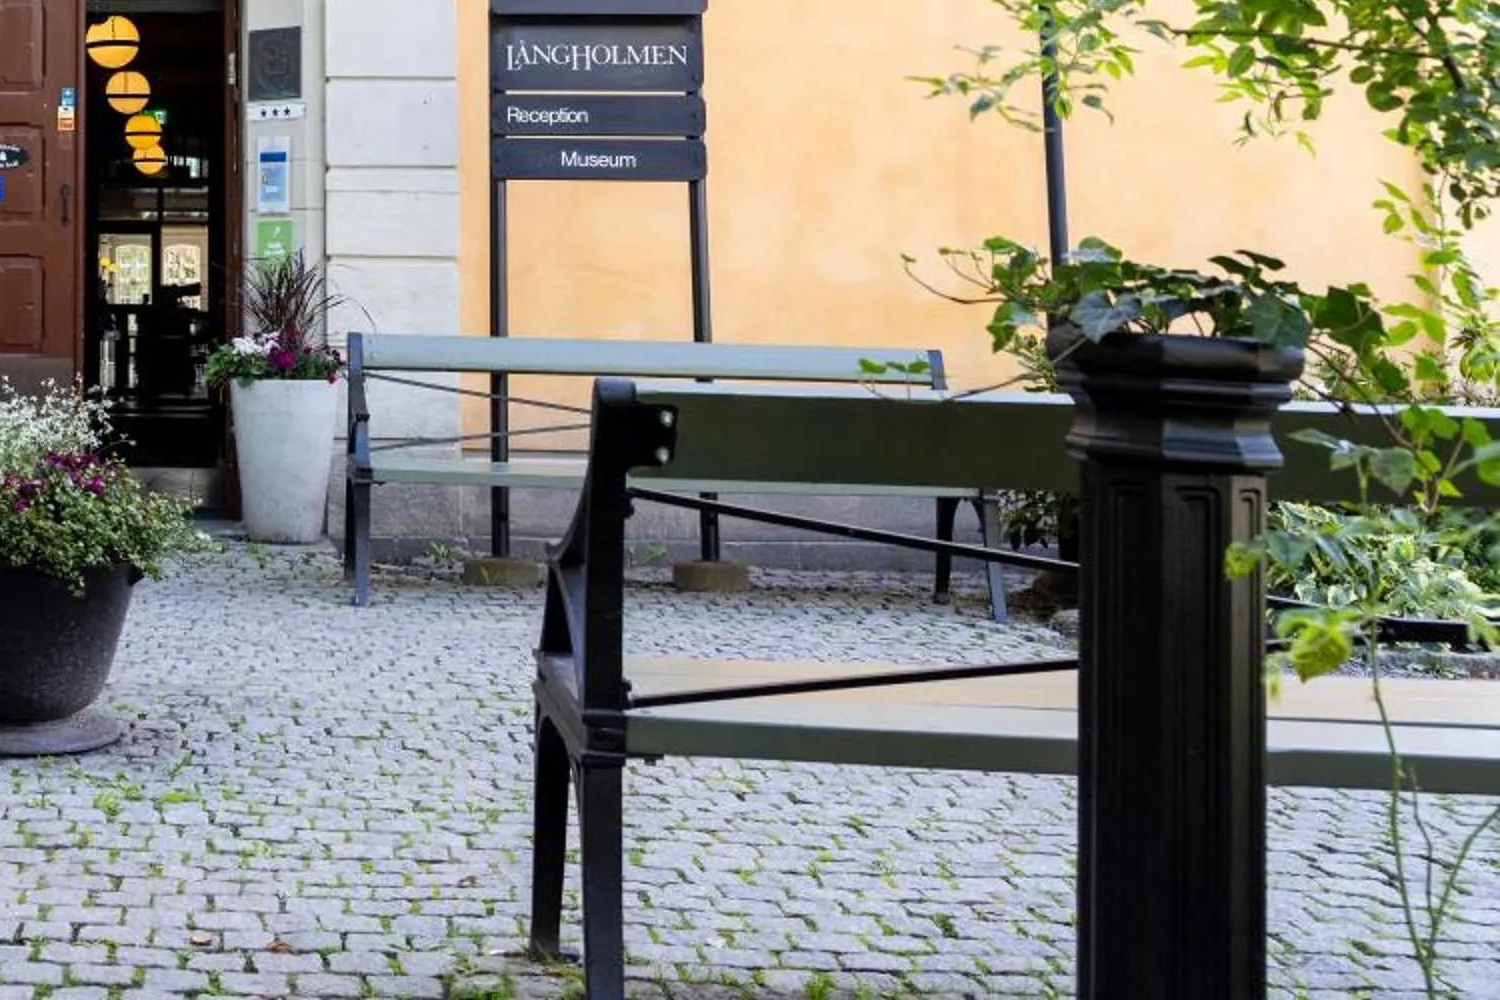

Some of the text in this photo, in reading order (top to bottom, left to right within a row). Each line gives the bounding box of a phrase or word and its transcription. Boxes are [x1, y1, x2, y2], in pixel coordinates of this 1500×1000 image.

[506, 39, 688, 72] LÅNGHOLMEN
[506, 106, 589, 127] Reception
[560, 151, 637, 169] Museum
